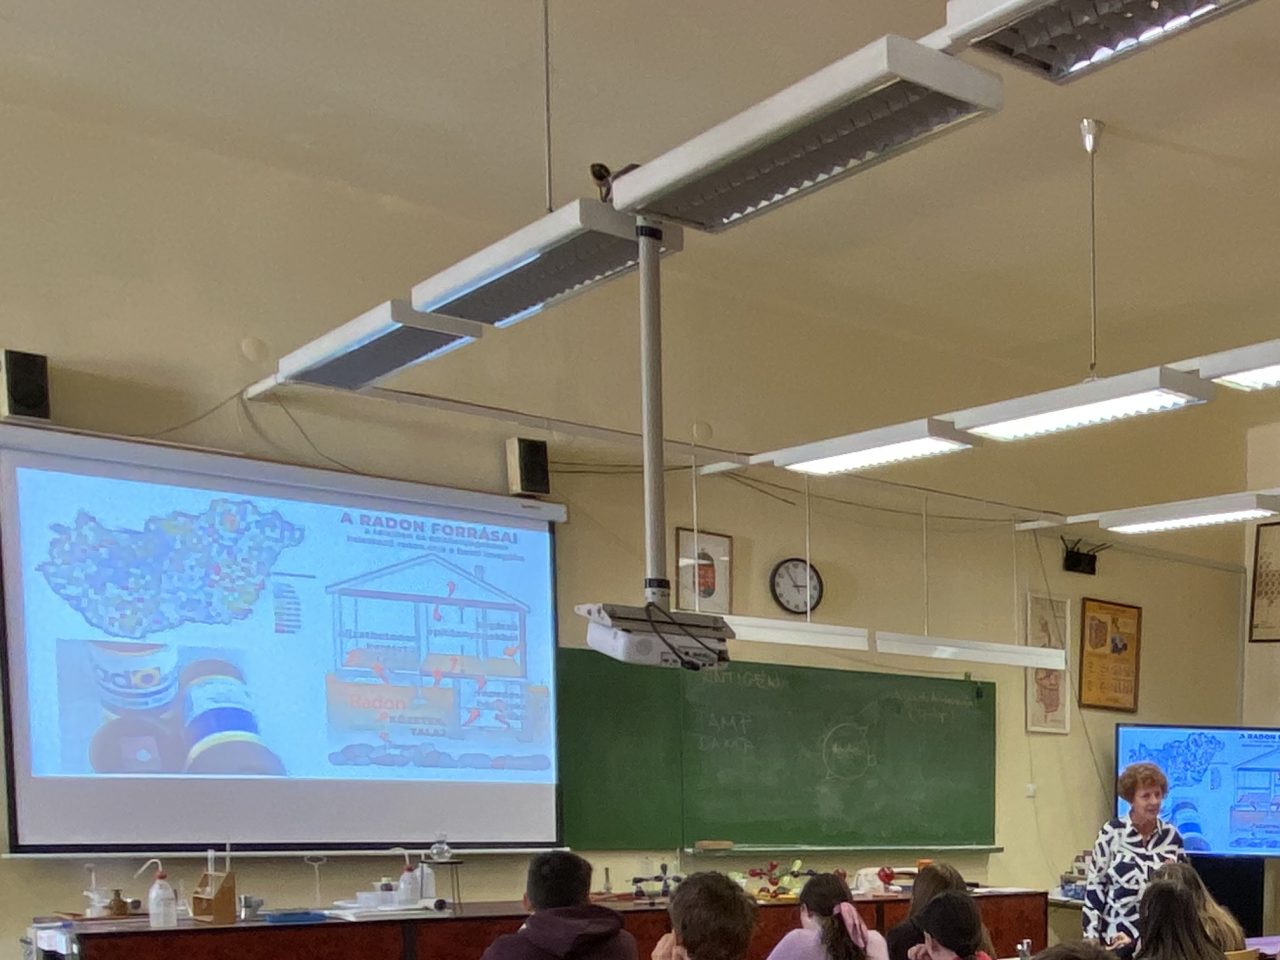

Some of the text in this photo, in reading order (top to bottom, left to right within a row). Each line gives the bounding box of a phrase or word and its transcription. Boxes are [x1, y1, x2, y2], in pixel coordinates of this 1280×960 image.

[341, 511, 353, 526] A
[359, 514, 425, 533] RADON
[431, 522, 518, 544] FORRÁSAI
[351, 694, 406, 710] Radon
[1247, 733, 1276, 741] RADON
